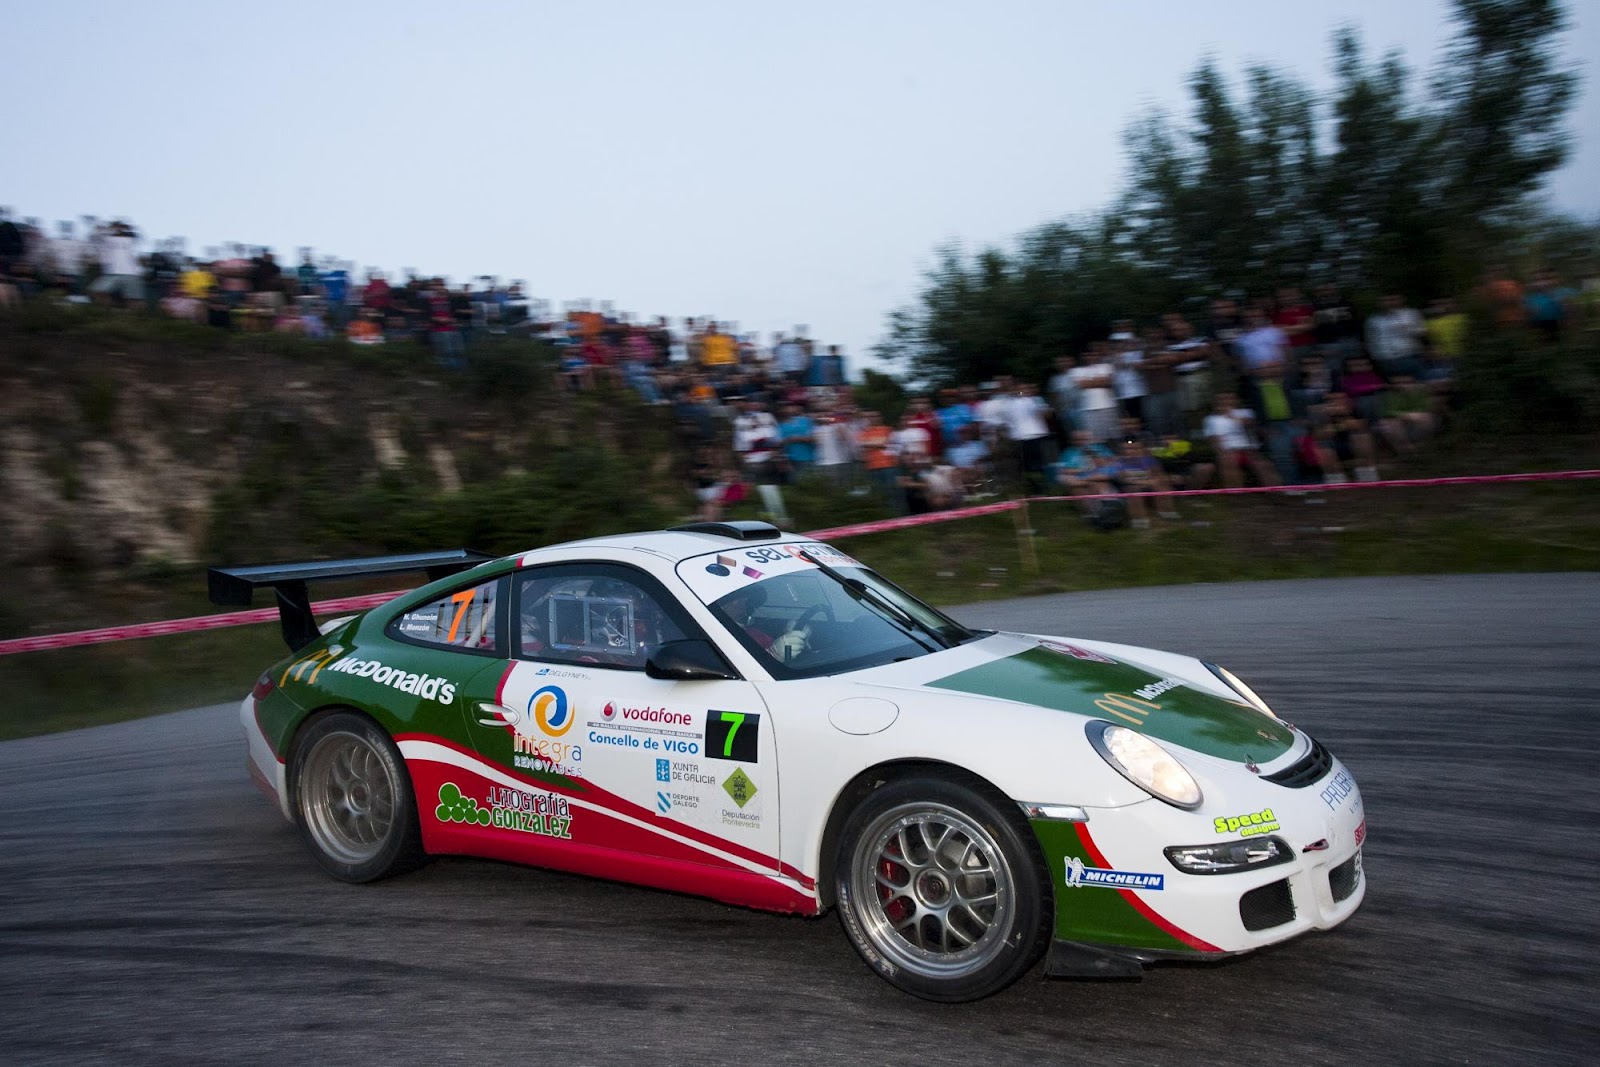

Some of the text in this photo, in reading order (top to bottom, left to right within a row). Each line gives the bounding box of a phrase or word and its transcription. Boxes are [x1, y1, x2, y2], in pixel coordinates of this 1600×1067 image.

[447, 589, 477, 643] 7
[328, 657, 456, 705] McDonald's
[622, 706, 692, 726] vodafone
[589, 731, 699, 755] Concello de VIGO
[720, 711, 745, 757] 7
[513, 729, 582, 763] integra
[513, 754, 583, 777] RENOVABLES
[672, 762, 699, 773] XUNTA
[672, 772, 716, 785] DE GALICIA
[672, 793, 700, 803] DEPORTE
[672, 801, 698, 809] GALEGO
[721, 809, 760, 821] Deputación
[1214, 808, 1277, 834] Speed
[1085, 871, 1161, 887] MICHELIN
